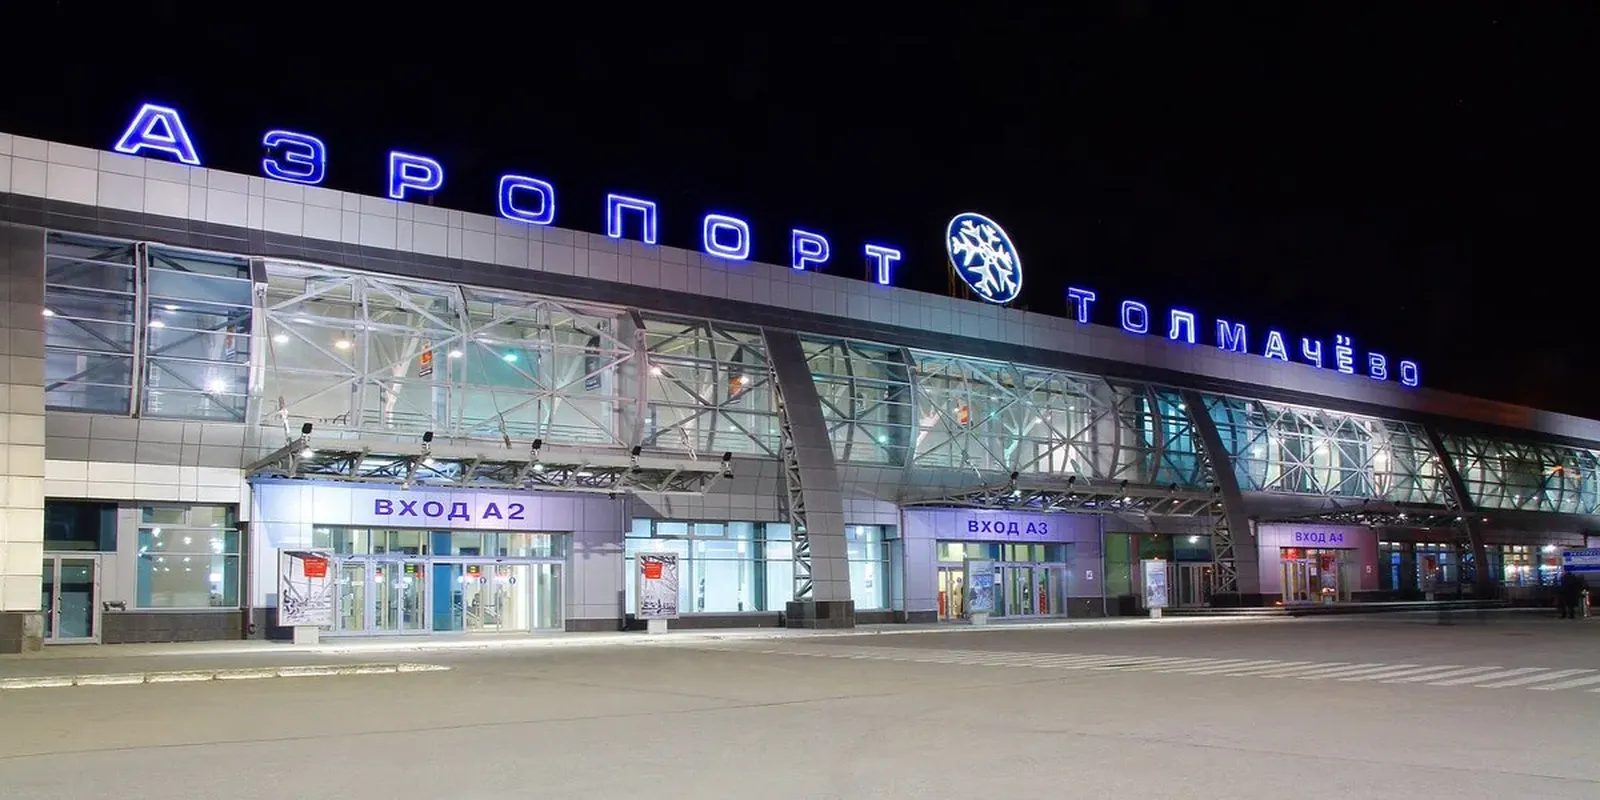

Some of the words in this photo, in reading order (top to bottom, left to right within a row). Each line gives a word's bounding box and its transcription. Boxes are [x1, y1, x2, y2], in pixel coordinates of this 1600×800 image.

[113, 102, 902, 286] АЭРОПОРТ
[1067, 287, 1419, 387] ТОЛМАЧЁВО
[374, 499, 470, 521] ВХОД
[483, 502, 525, 520] А2
[968, 520, 1020, 536] ВХОД
[1025, 522, 1048, 535] А3
[1295, 531, 1326, 543] ВХОД
[1329, 532, 1344, 543] А4
